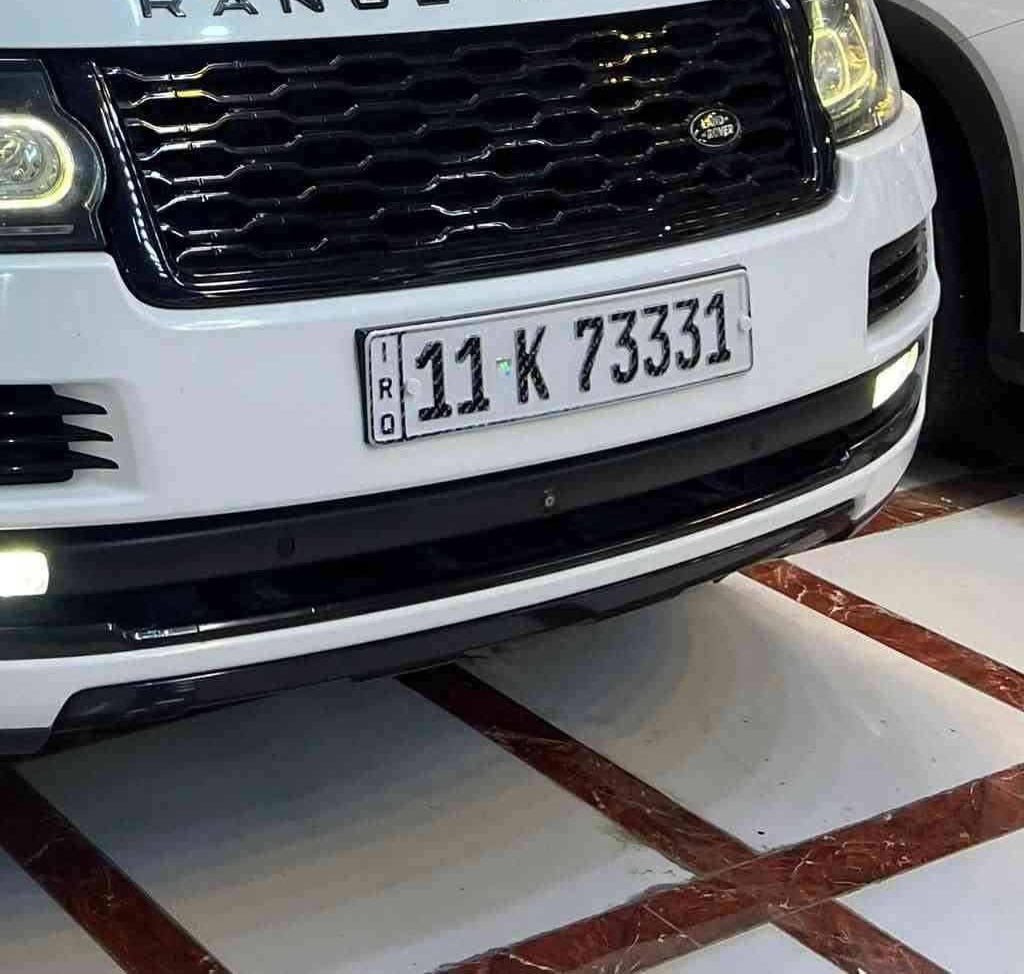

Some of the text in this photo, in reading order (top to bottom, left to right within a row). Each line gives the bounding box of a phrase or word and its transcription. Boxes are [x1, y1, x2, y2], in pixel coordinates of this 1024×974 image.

[414, 292, 732, 422] 11 K 73331
